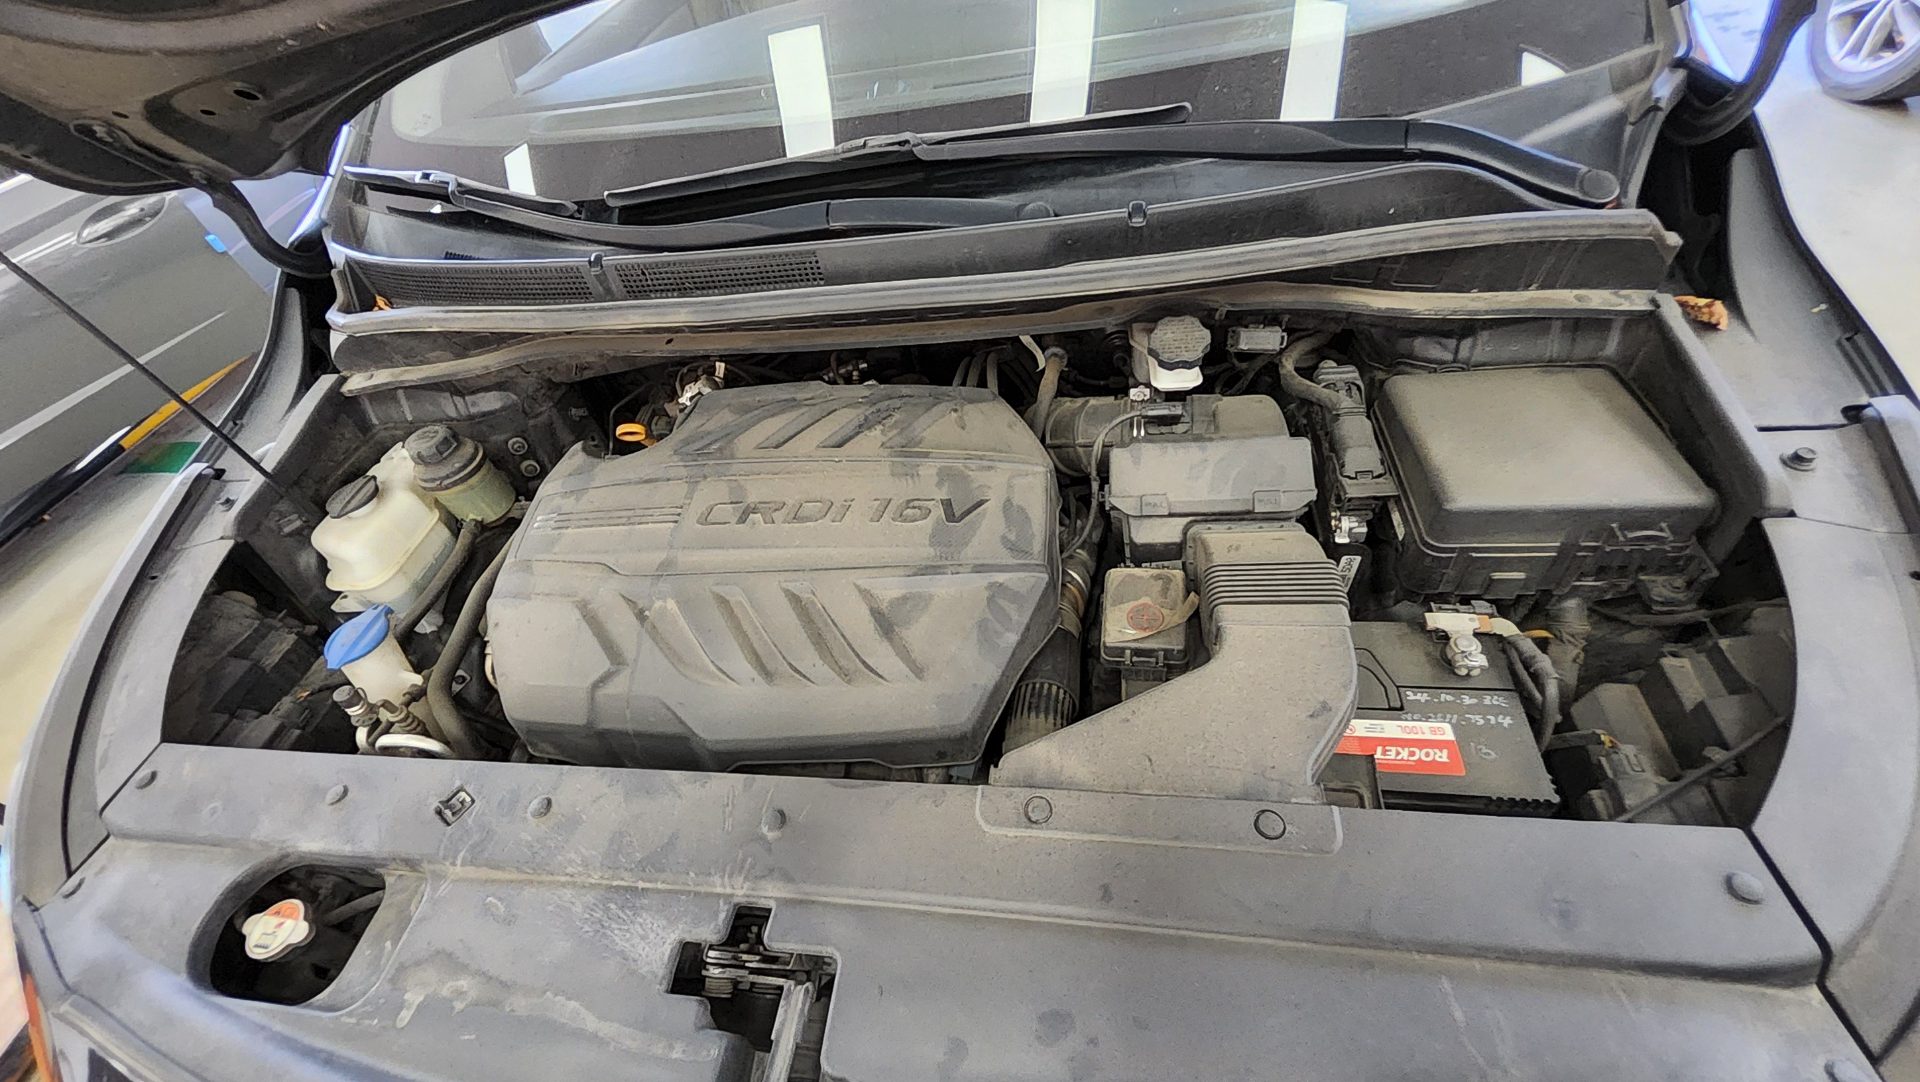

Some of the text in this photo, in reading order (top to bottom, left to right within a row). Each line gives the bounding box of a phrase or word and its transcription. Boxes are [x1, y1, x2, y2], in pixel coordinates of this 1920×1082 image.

[696, 498, 991, 525] CRDi 16V
[1396, 724, 1425, 735] 100L
[1425, 726, 1446, 736] GB
[1374, 745, 1450, 763] ROCKET
